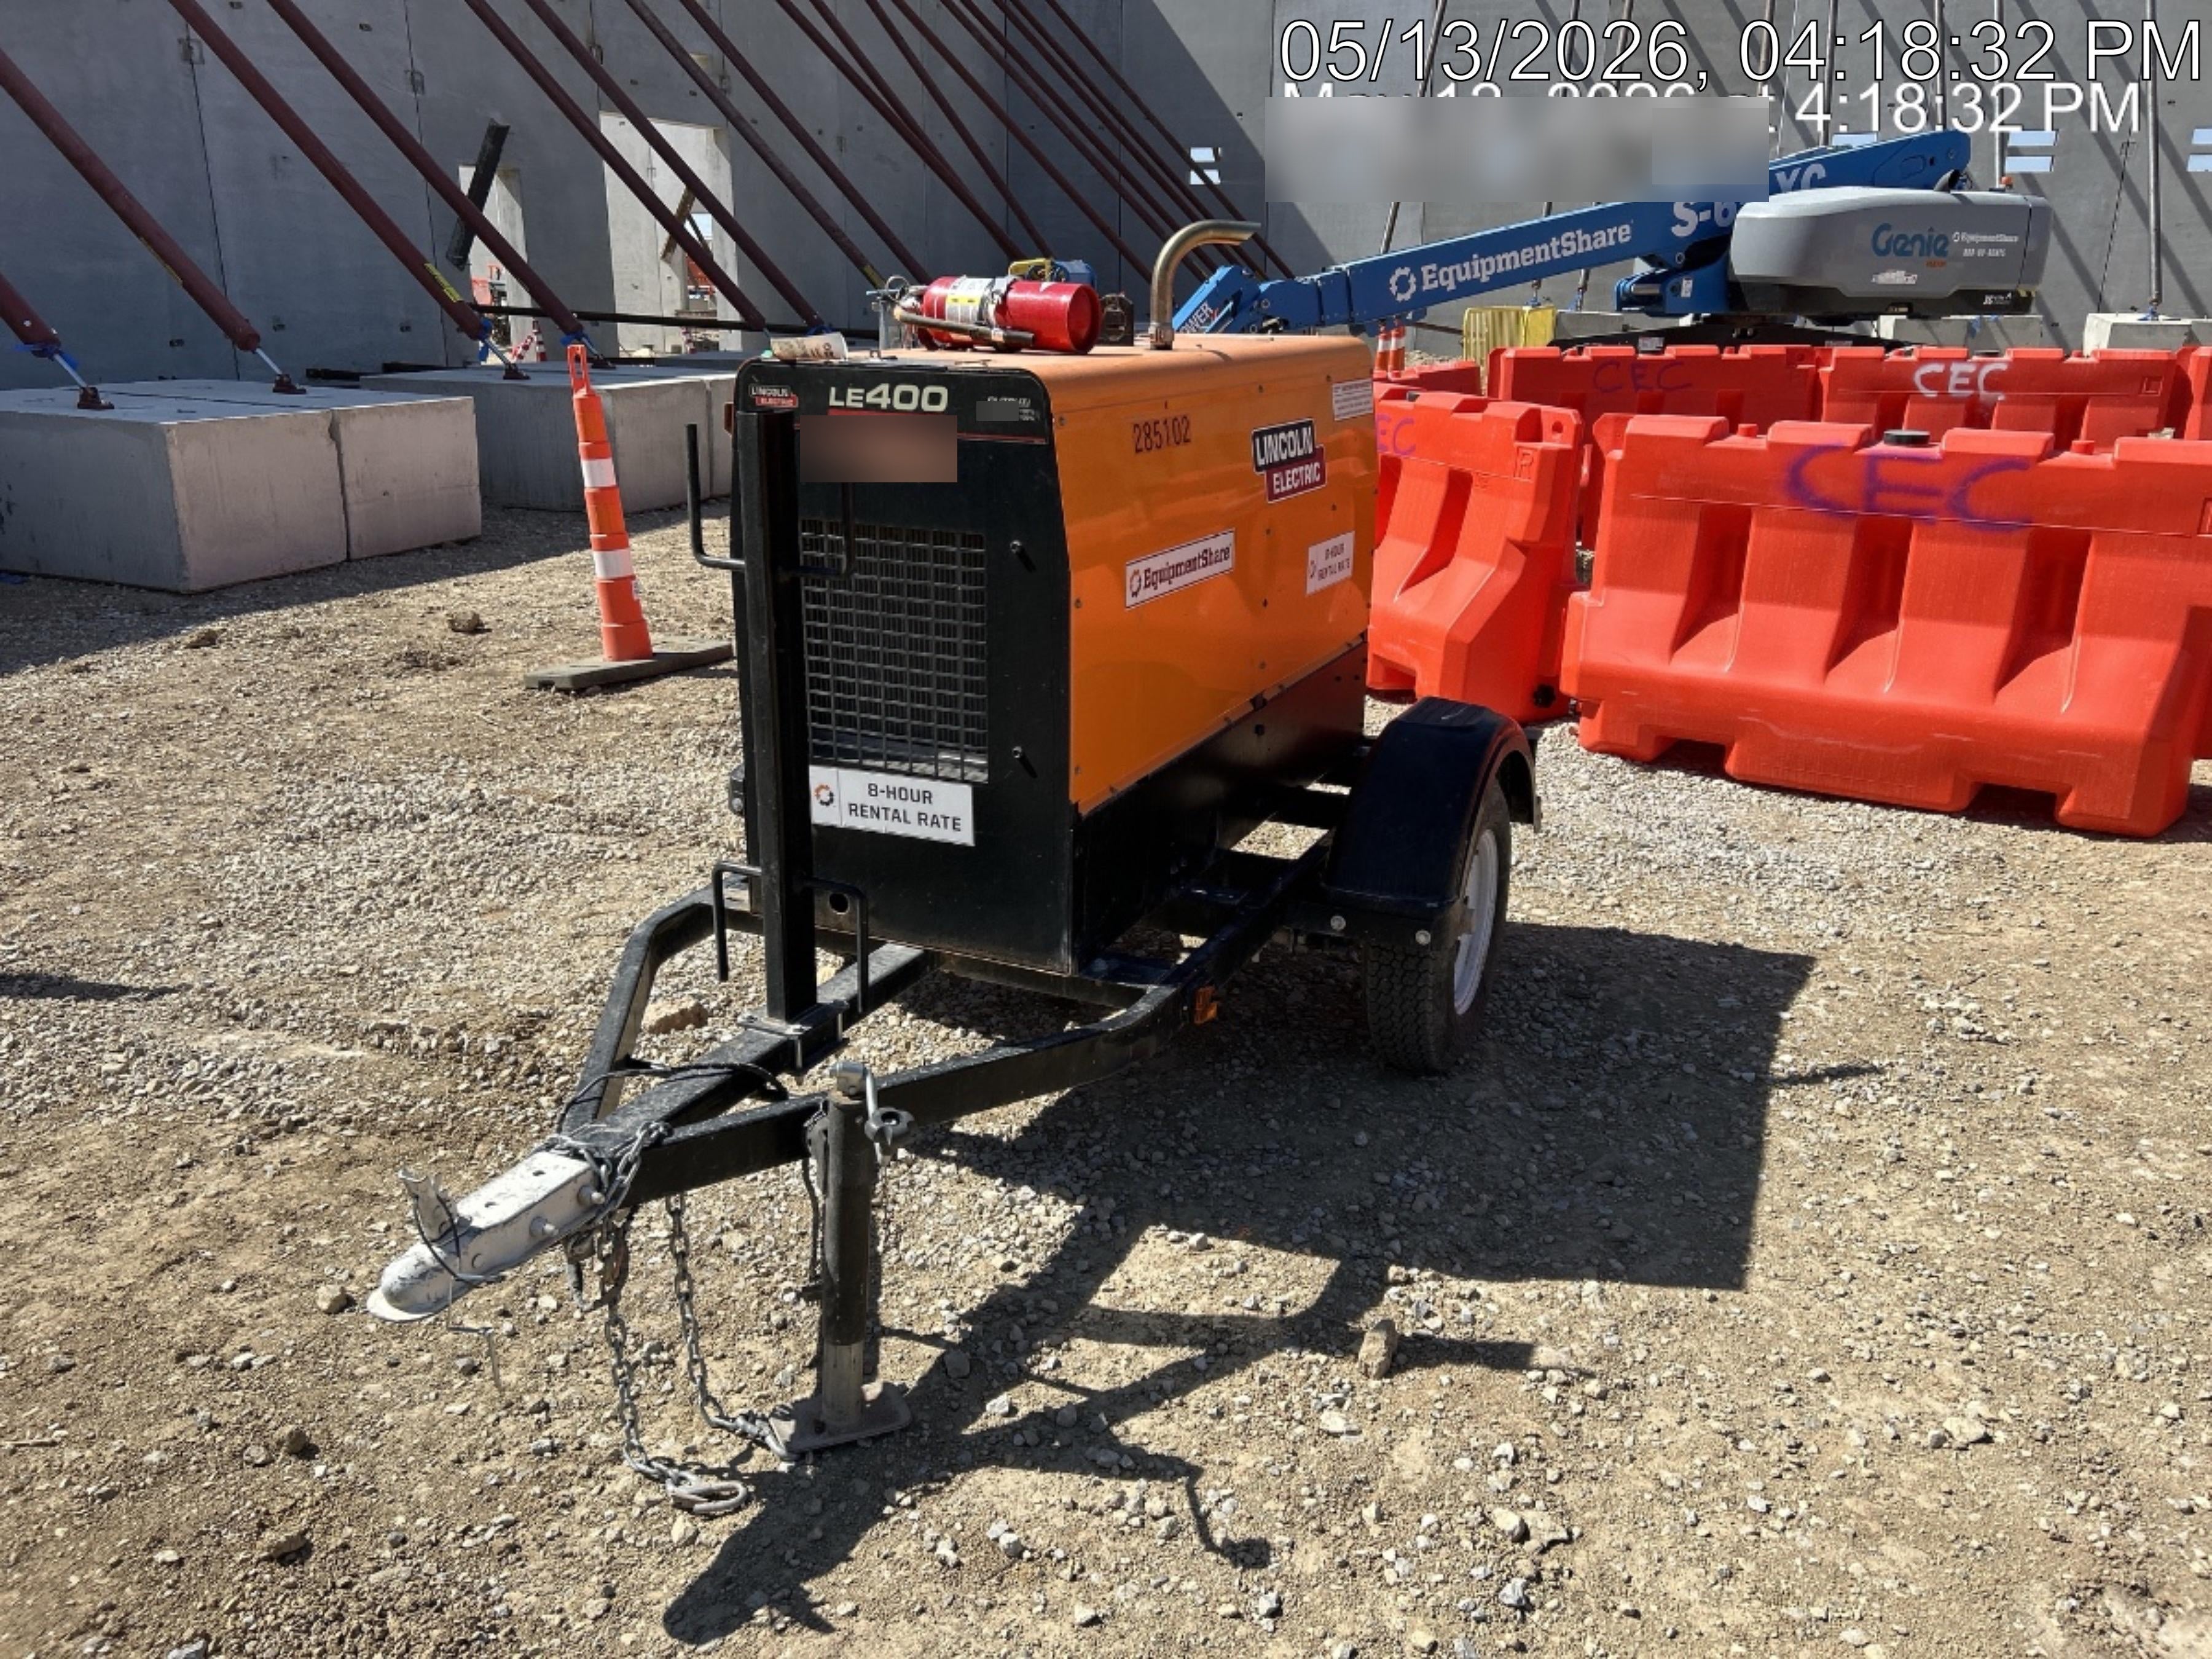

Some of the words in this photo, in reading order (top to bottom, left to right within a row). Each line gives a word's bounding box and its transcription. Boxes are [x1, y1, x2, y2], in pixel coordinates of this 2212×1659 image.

[1422, 225, 1631, 291] EquipmentShare
[1871, 222, 1949, 257] Genie
[829, 383, 948, 412] LE400
[1913, 363, 2009, 400] CEC
[1132, 415, 1191, 455] 285102
[1255, 426, 1313, 467] LINCOLN
[1273, 462, 1321, 495] ELECTRIC
[1784, 440, 2033, 535] CEC
[1143, 543, 1231, 590] EquipmentShare
[868, 782, 933, 804] 8-HOUR
[849, 802, 911, 825] RENTAL
[917, 812, 962, 832] RATE
